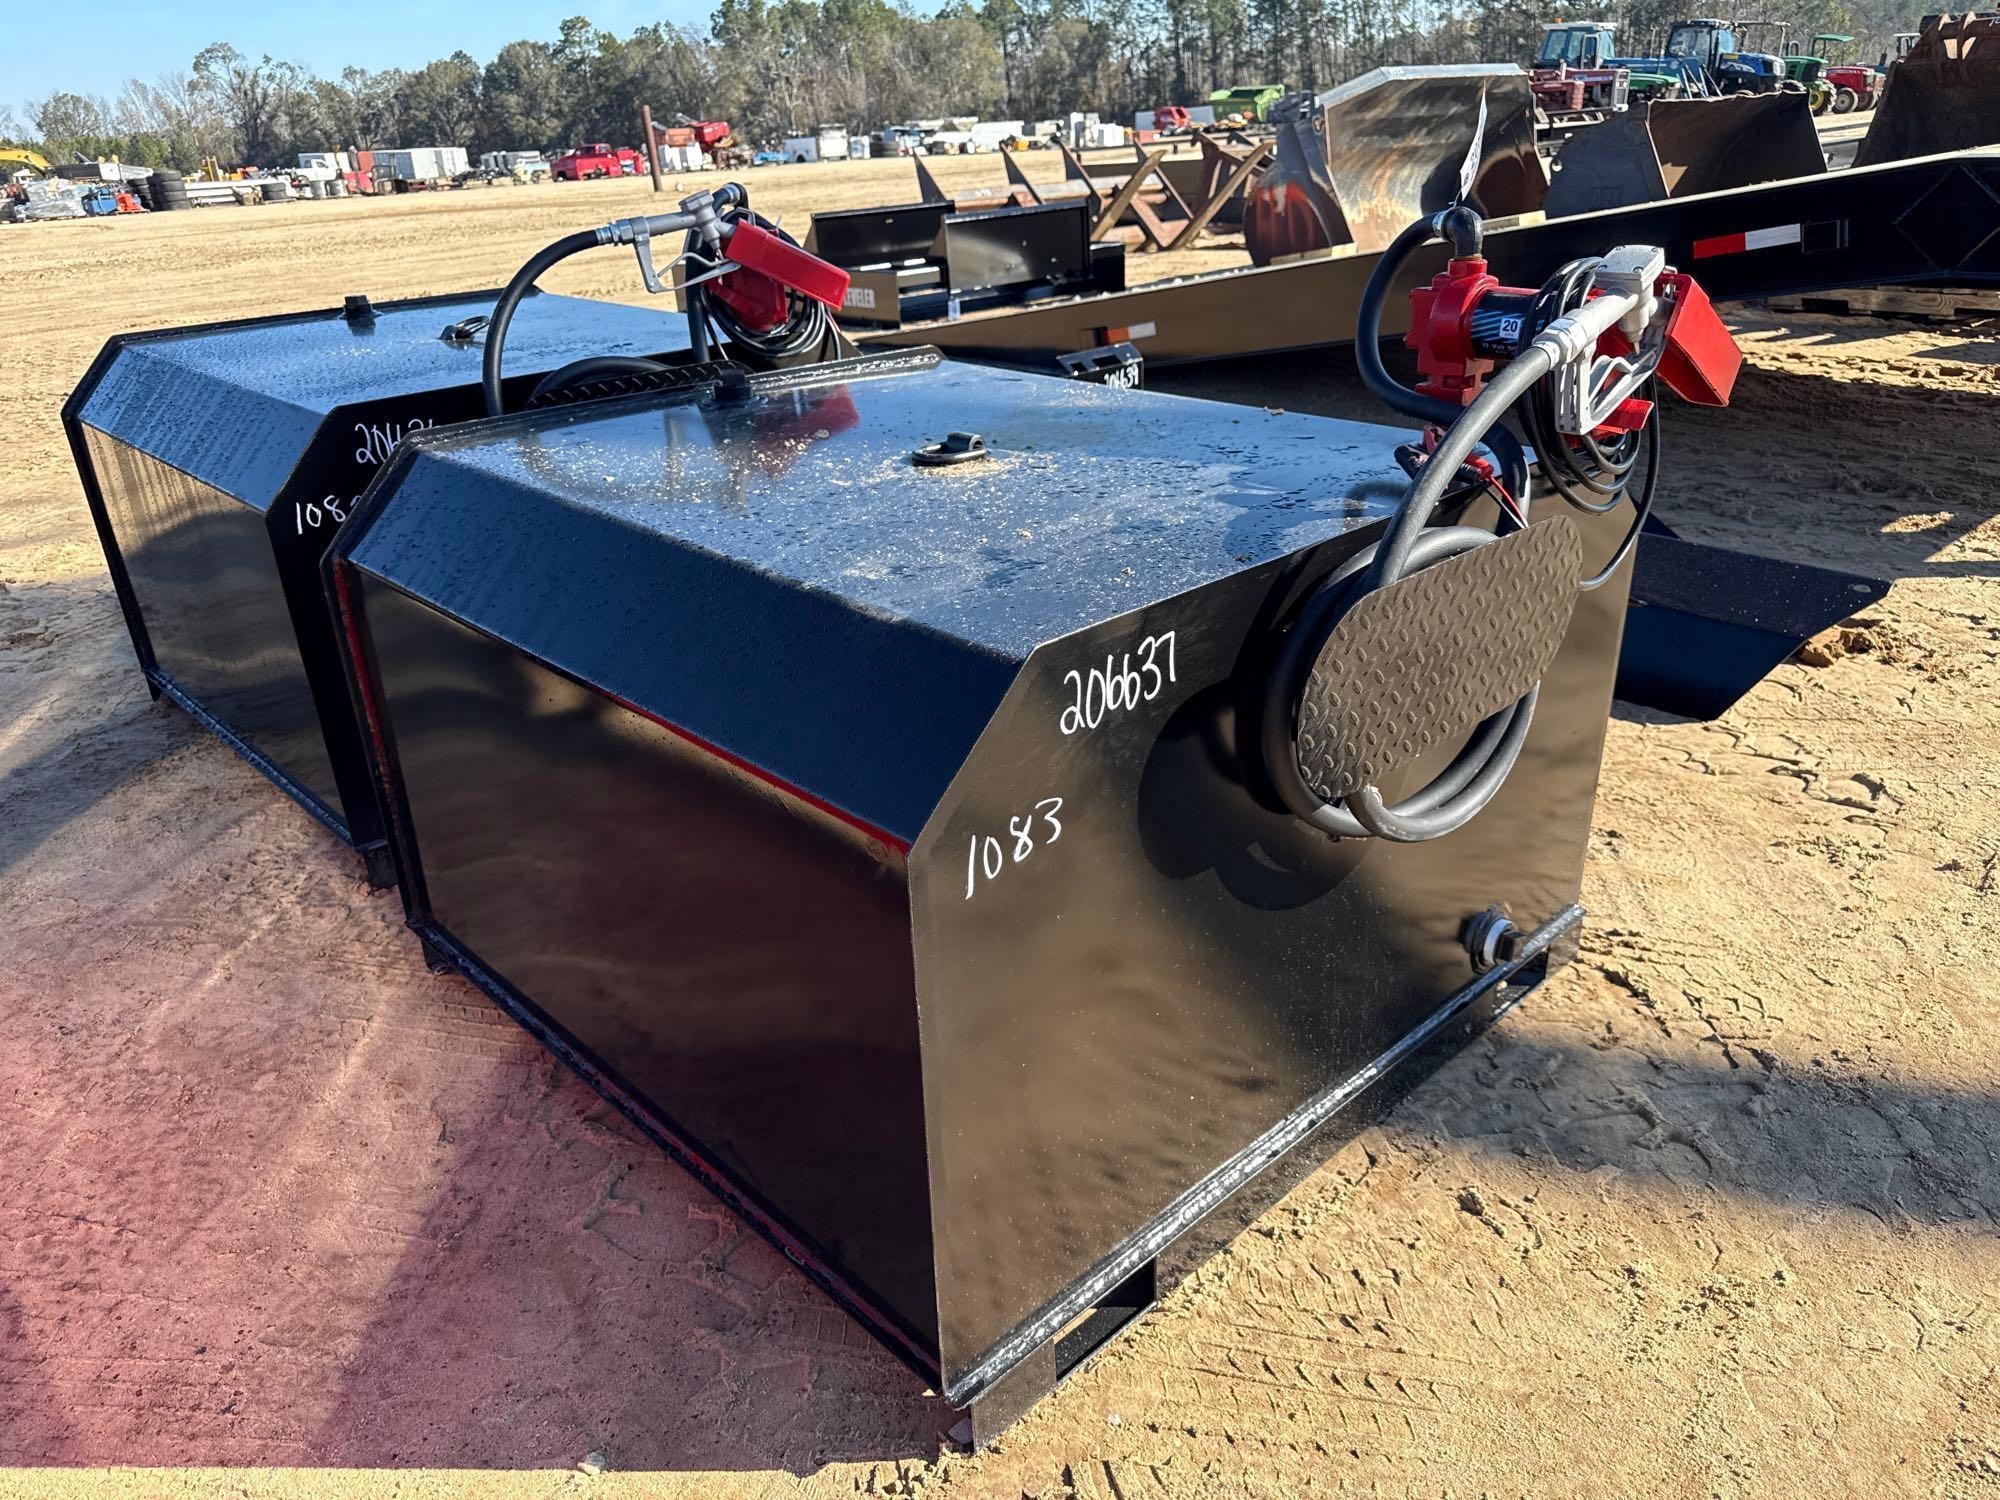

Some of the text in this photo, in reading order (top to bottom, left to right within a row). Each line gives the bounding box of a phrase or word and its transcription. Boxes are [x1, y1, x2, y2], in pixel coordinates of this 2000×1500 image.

[1502, 320, 1518, 332] 20
[296, 494, 362, 535] 108
[1060, 631, 1176, 735] 206637
[965, 797, 1063, 900] 1083
